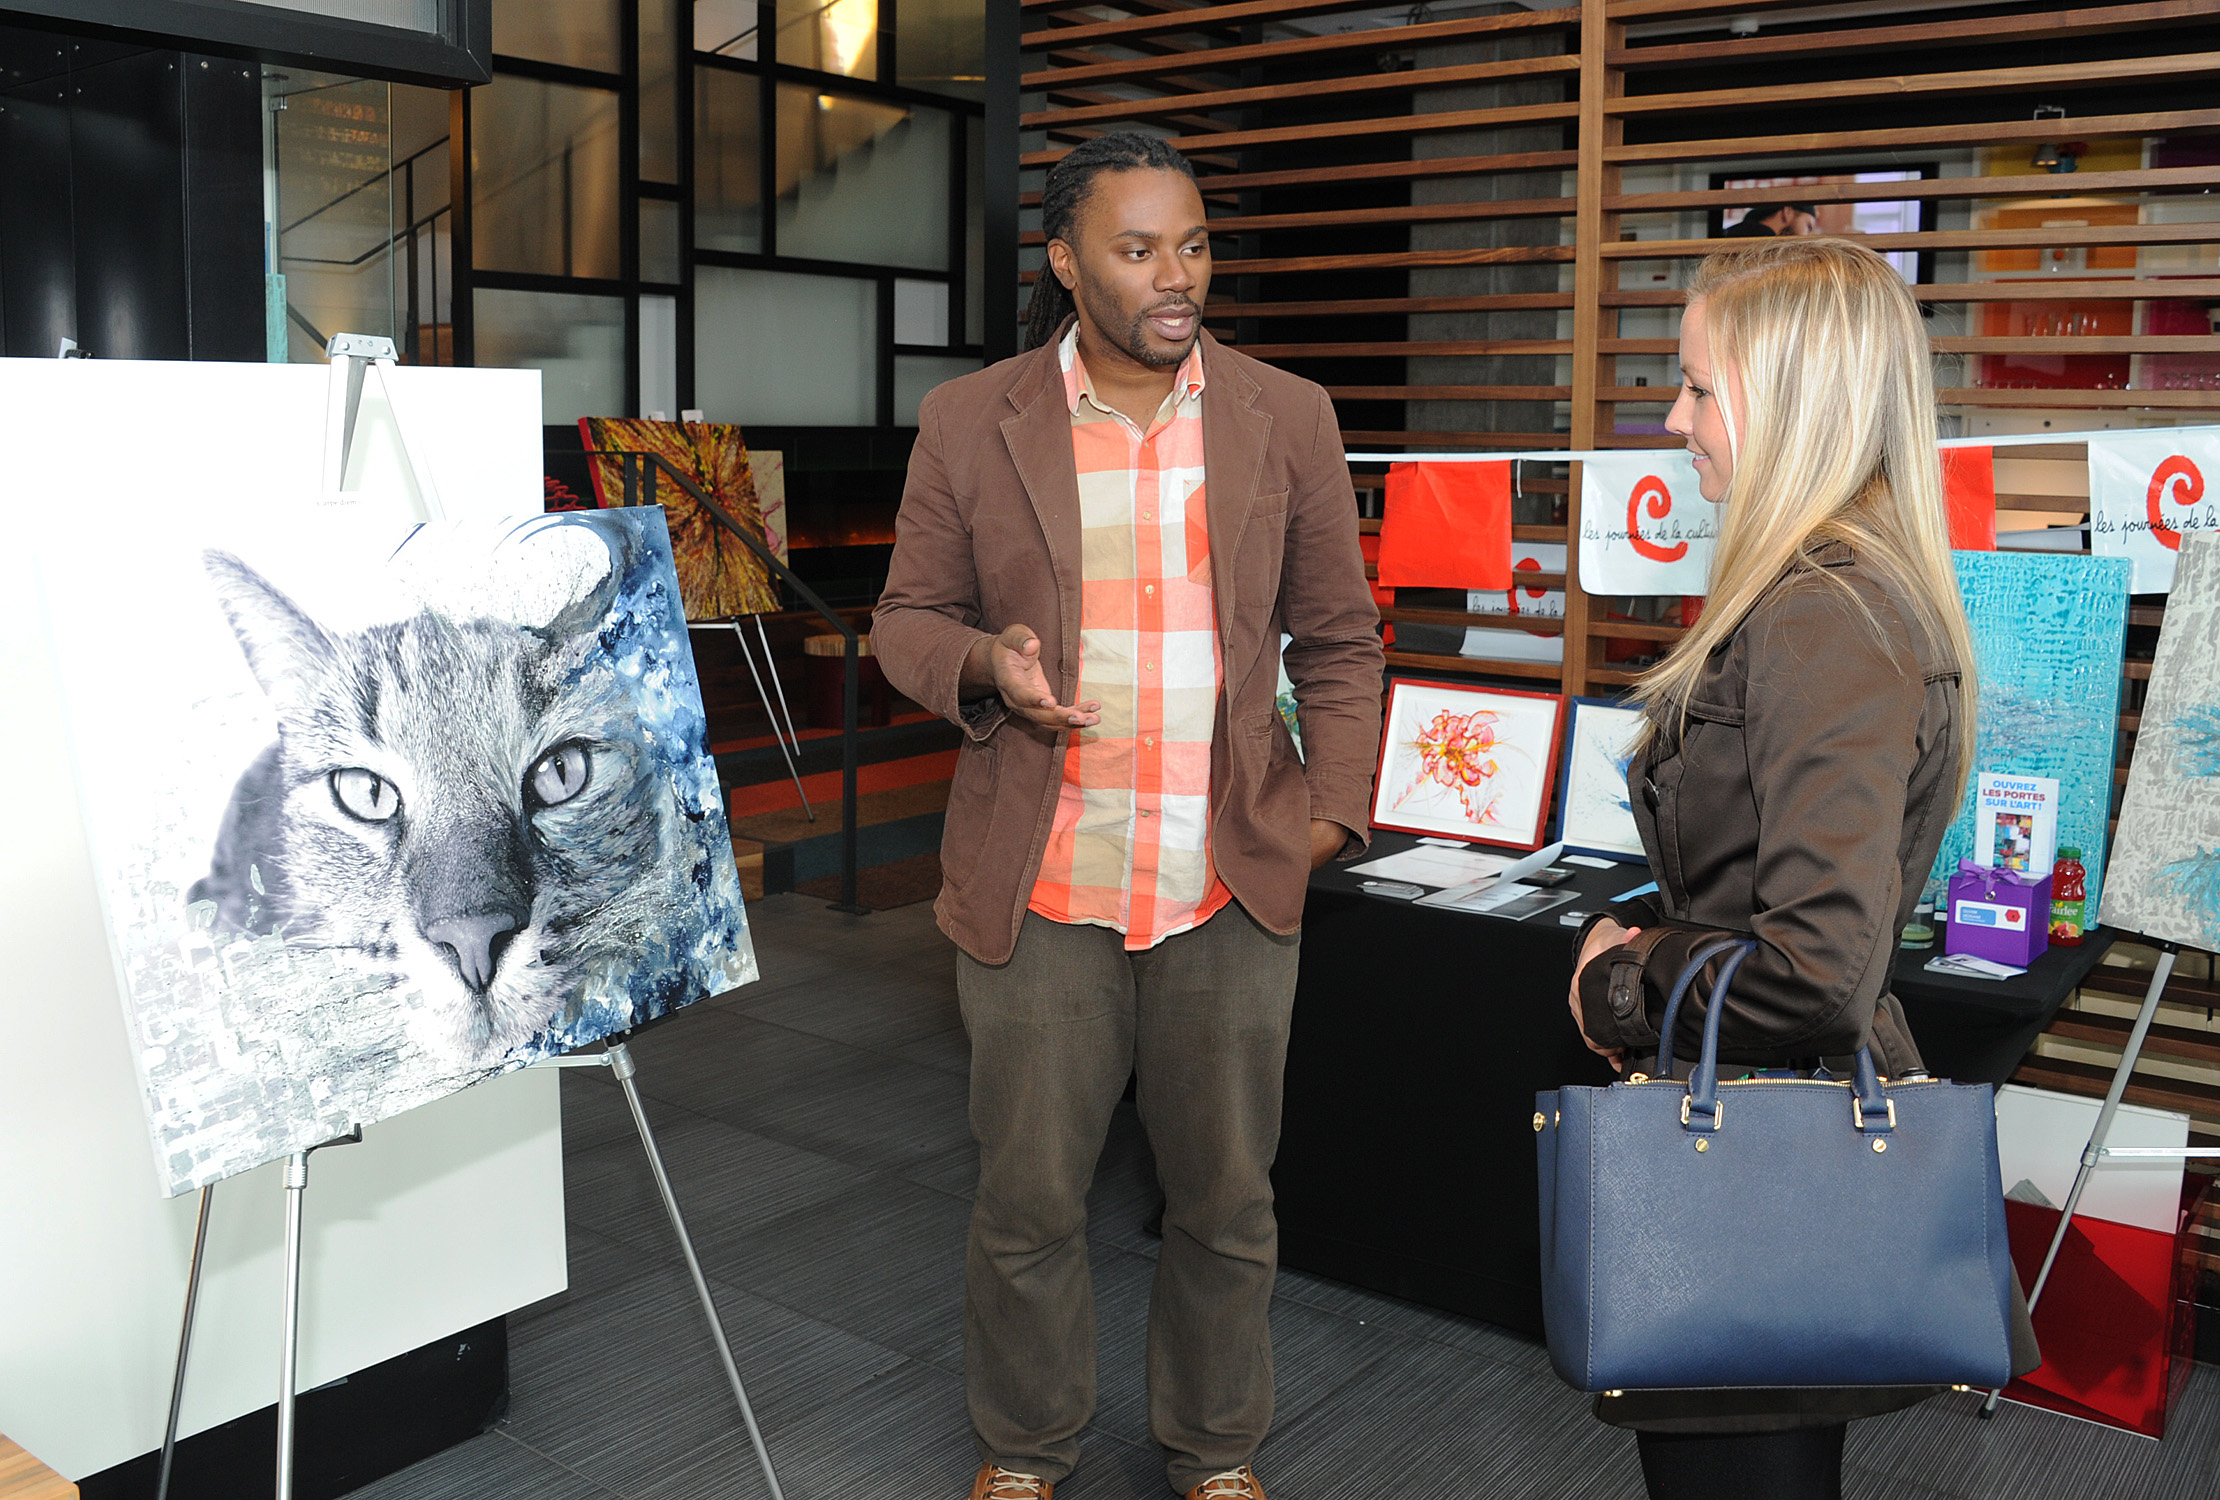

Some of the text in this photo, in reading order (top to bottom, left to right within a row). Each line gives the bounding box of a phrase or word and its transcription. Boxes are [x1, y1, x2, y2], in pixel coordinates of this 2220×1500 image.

[2095, 505, 2218, 545] les journées de la
[1583, 518, 1716, 551] les journées de la cultu
[1993, 780, 2037, 791] OUVREZ
[1983, 788, 2046, 802] LES PORTES
[1985, 798, 2007, 807] SUR
